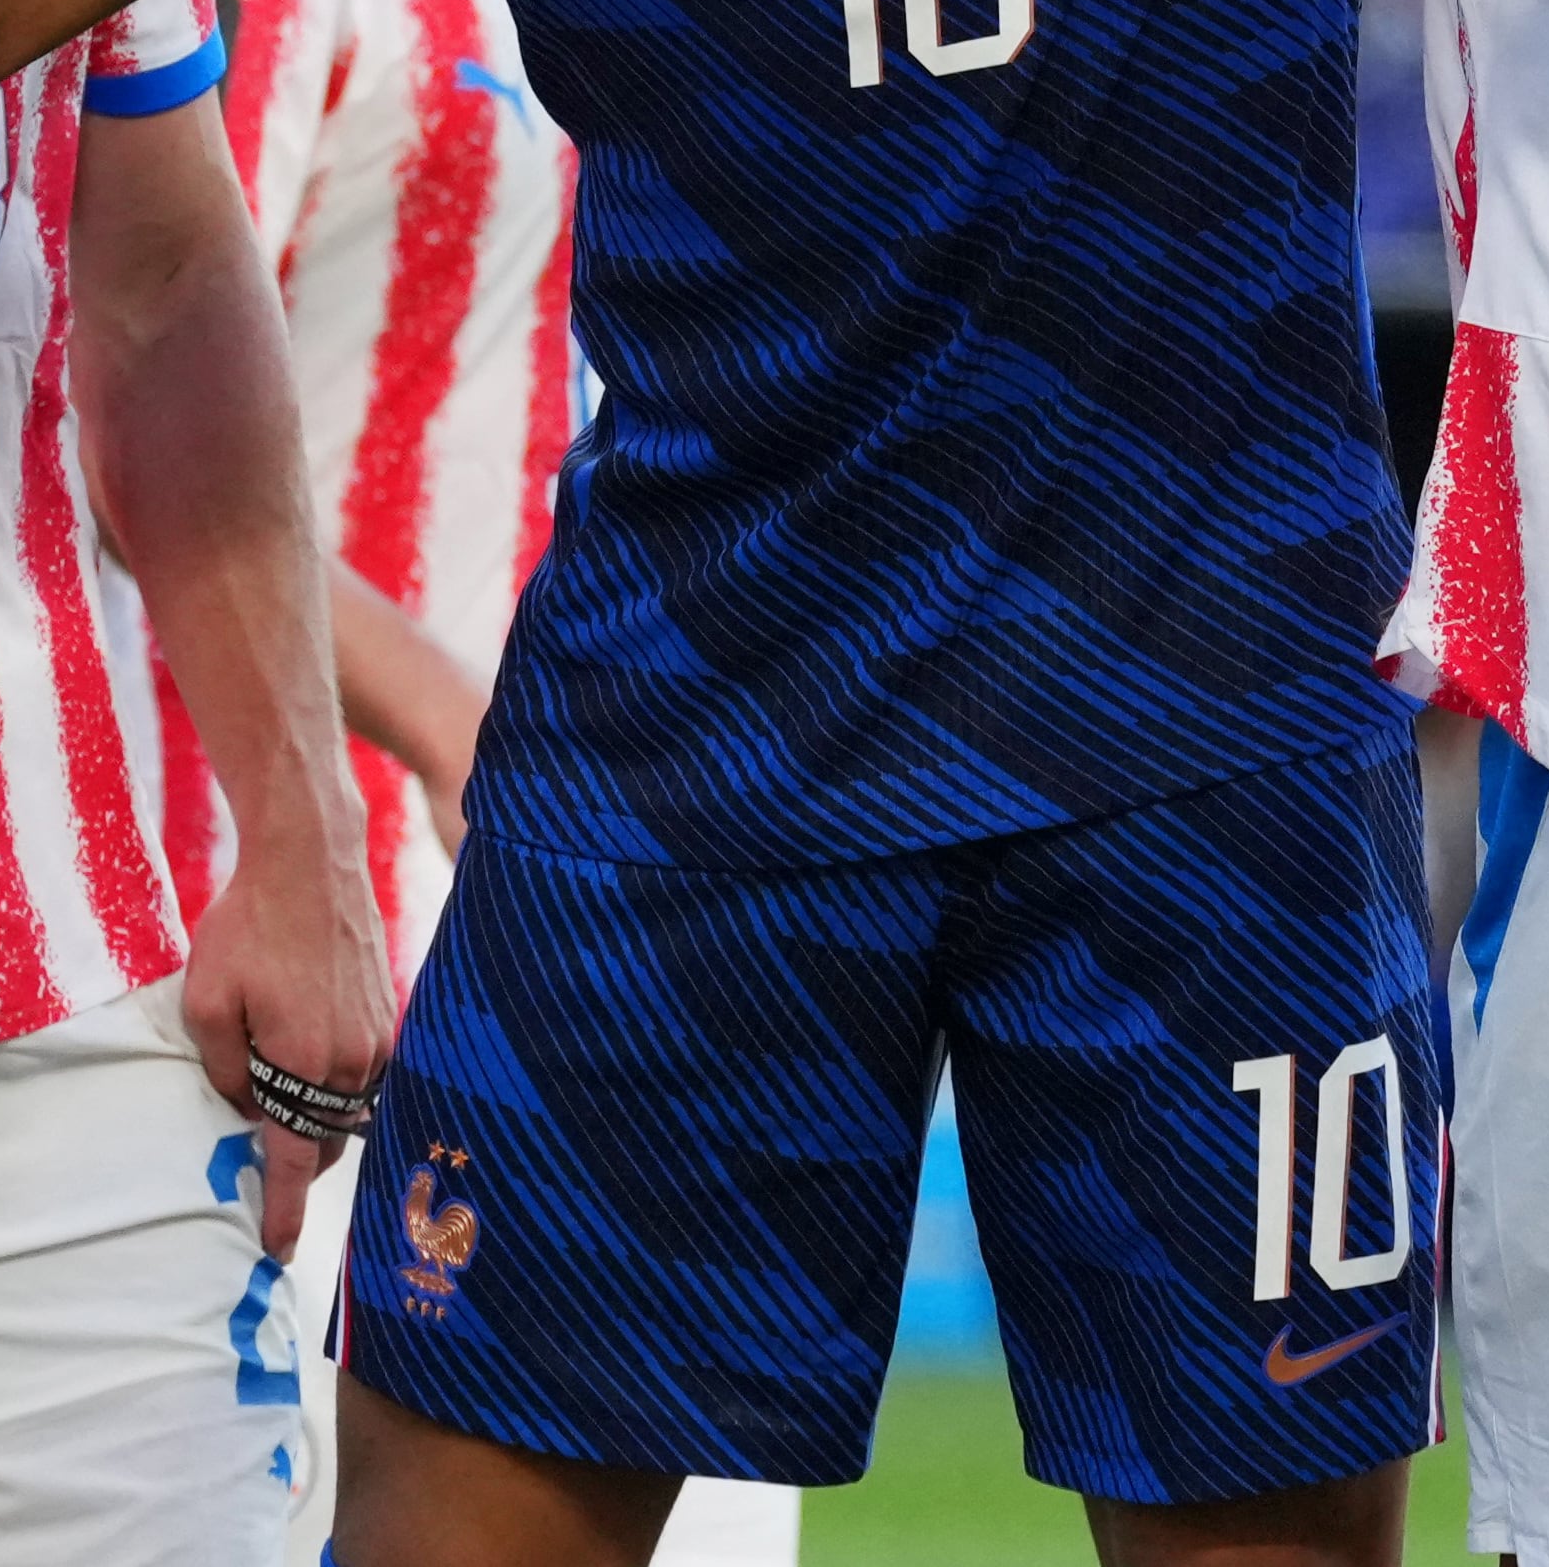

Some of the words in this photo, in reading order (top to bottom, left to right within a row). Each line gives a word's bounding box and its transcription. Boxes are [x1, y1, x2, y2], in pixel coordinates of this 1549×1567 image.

[273, 1073, 303, 1098] MIT
[263, 1099, 293, 1124] AUX
[1232, 1032, 1411, 1302] 10
